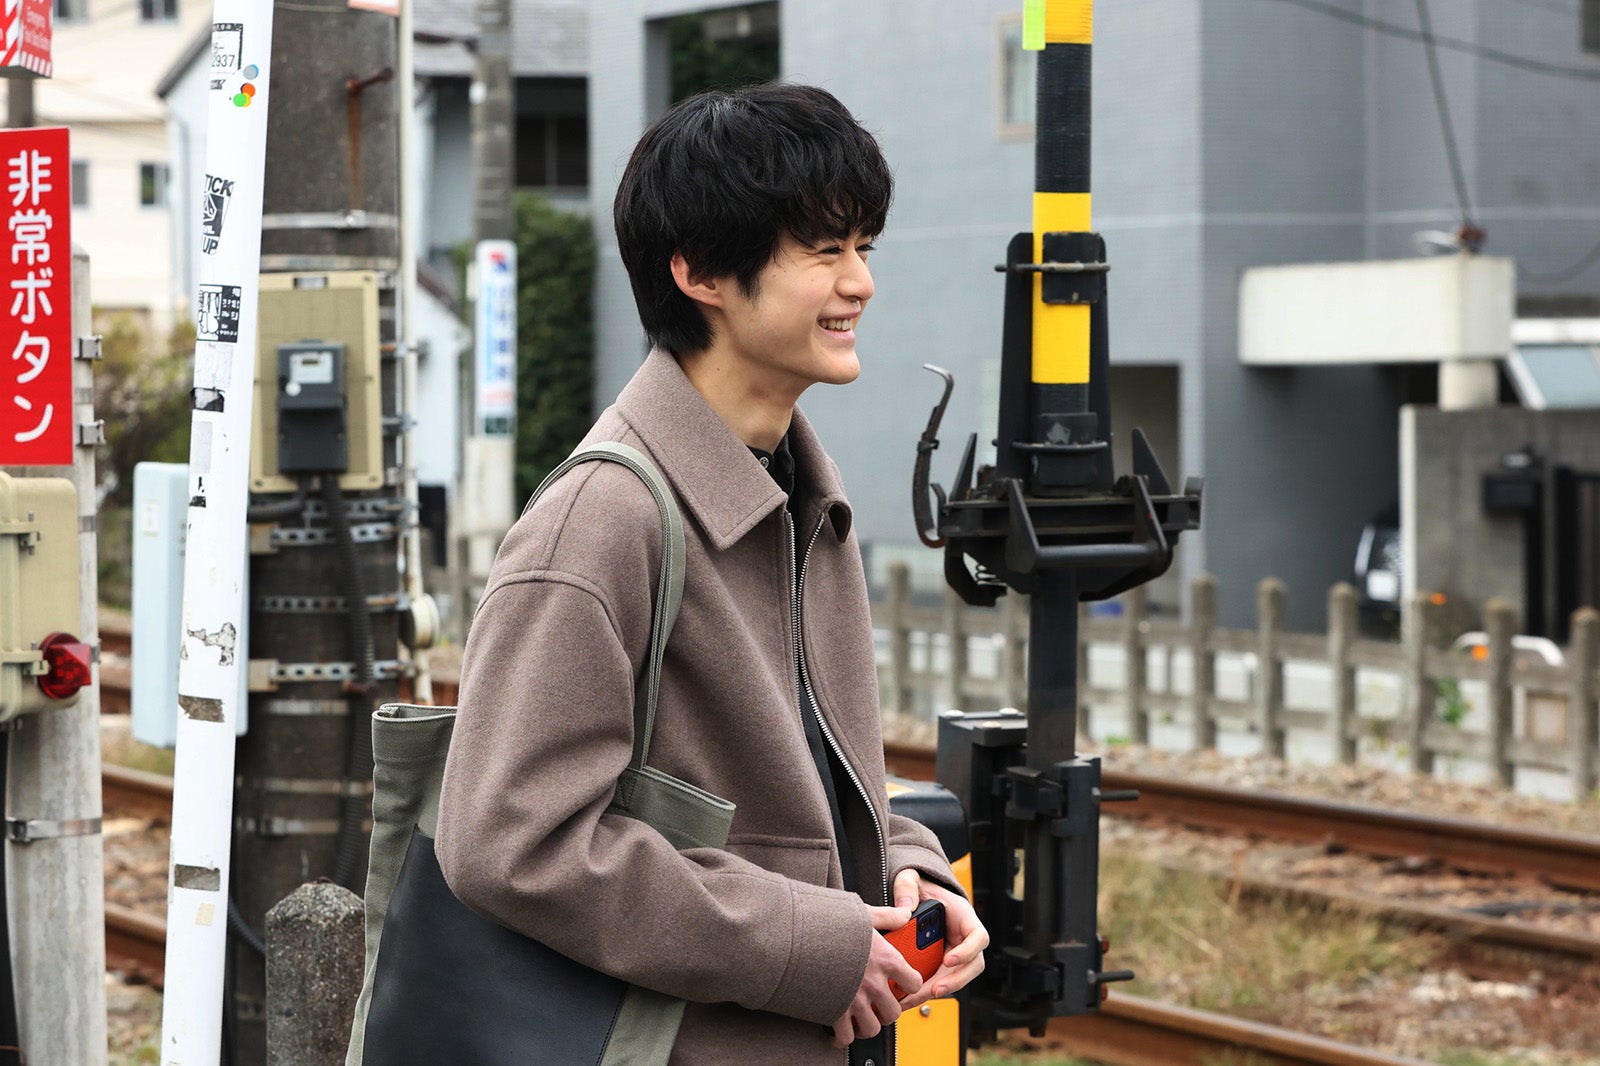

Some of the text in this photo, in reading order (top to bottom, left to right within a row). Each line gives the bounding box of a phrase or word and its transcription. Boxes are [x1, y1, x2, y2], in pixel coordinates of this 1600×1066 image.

[8, 149, 53, 443] 非常ボタン
